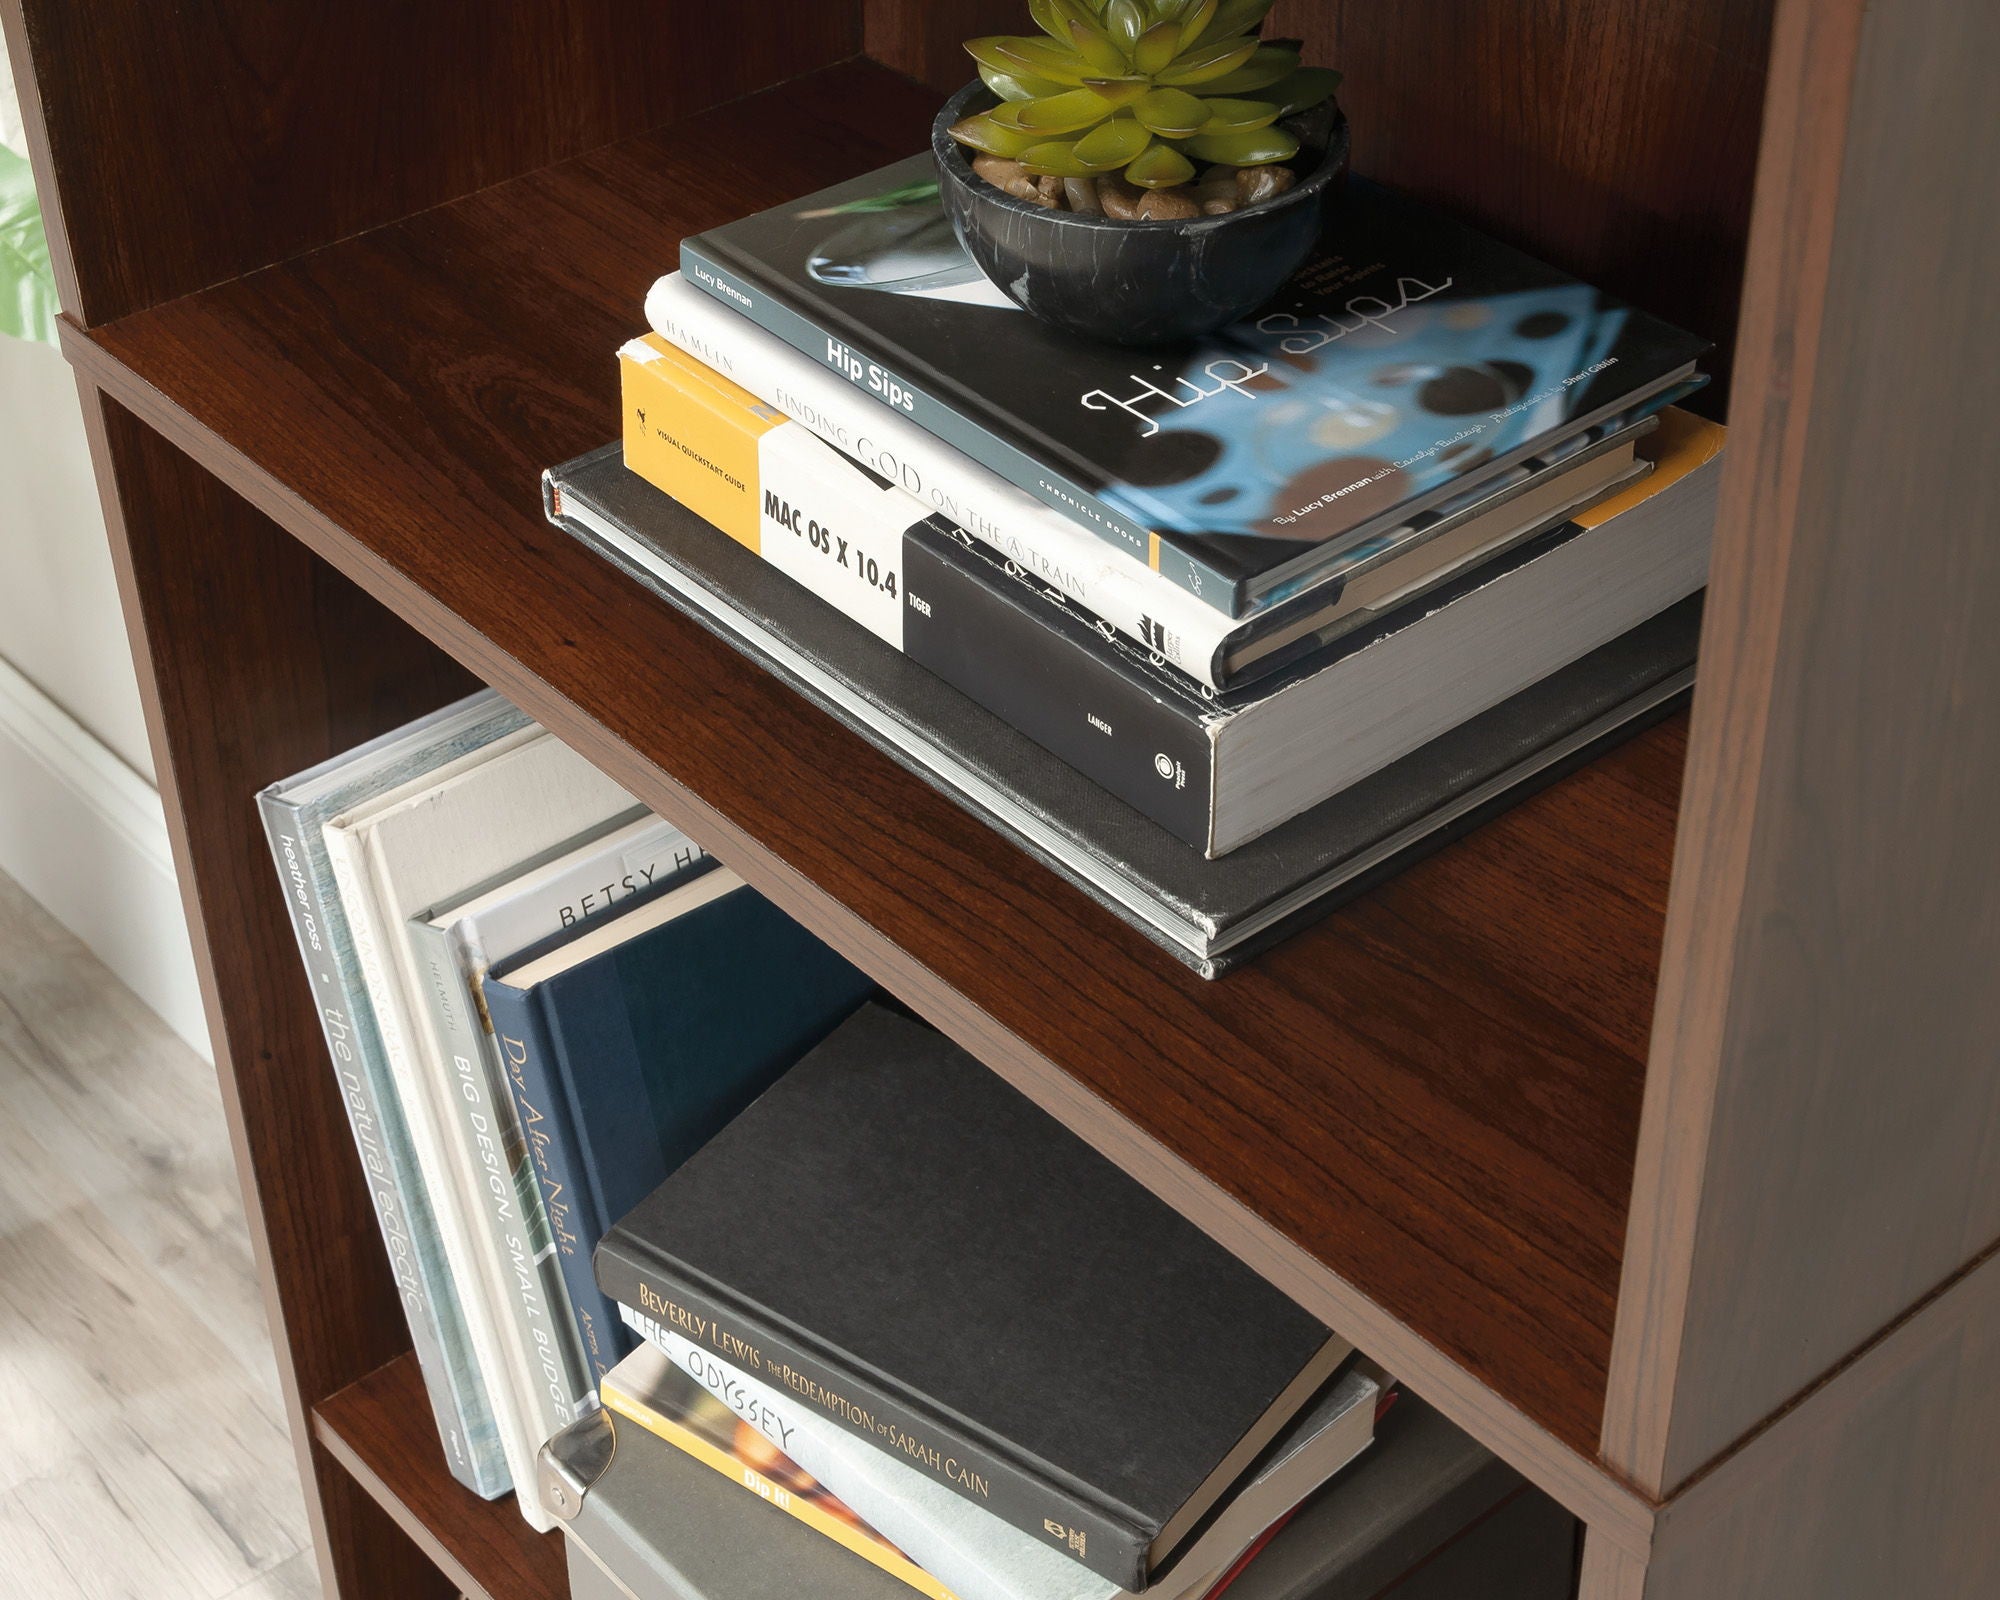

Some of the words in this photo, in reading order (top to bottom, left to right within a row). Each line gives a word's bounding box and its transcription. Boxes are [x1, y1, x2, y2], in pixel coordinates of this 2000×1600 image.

[695, 264, 716, 287] Lucy
[717, 278, 752, 308] Brennan
[666, 319, 733, 372] HAMLIN
[828, 338, 862, 381] Hip
[868, 364, 914, 412] Sips
[1081, 359, 1268, 438] Hip
[1256, 276, 1452, 354] Sips
[1562, 370, 1590, 387] Sheri
[1588, 357, 1619, 374] Giblin
[657, 429, 680, 450] VISUAL
[681, 445, 723, 479] QUICKSTART
[725, 473, 746, 493] GUIDE
[776, 388, 848, 446] FINDING
[858, 437, 920, 494] GOD
[931, 488, 958, 516] ON
[967, 509, 1001, 545] THE
[1007, 536, 1022, 558] A
[1029, 547, 1086, 599] TRAIN
[1273, 512, 1297, 525] By
[1293, 497, 1324, 517] Lucy
[1321, 477, 1372, 503] Brennan
[1371, 467, 1396, 481] with
[765, 489, 801, 537] MAC
[808, 519, 830, 554] OS
[837, 536, 848, 569] X
[857, 550, 897, 600] 10.4
[1039, 480, 1101, 522] CHRONICLE
[1107, 521, 1142, 548] BOOKS
[909, 592, 931, 618] TIGER
[1087, 713, 1112, 736] LANGER
[280, 834, 311, 910] heather
[303, 912, 322, 951] ross
[559, 863, 655, 928] BETSY
[430, 961, 457, 1031] HELMUTH
[325, 1008, 351, 1062] the
[343, 1071, 392, 1186] natural
[379, 1191, 424, 1312] eclectic
[502, 1033, 527, 1092] Day
[520, 1096, 550, 1172] After
[542, 1177, 577, 1256] Night
[454, 1055, 480, 1103] BIG
[471, 1112, 513, 1222] DESIGN,
[506, 1234, 540, 1317] SMALL
[639, 1283, 706, 1339] BEVERLY
[711, 1322, 761, 1369] LEWIS
[689, 1351, 795, 1449] ODYSSEY
[767, 1359, 782, 1379] THE
[784, 1366, 874, 1433] REDEMPTION
[890, 1425, 941, 1472] SARAH
[945, 1458, 988, 1499] CAIN
[744, 1470, 769, 1498] Dip
[774, 1486, 790, 1509] It!
